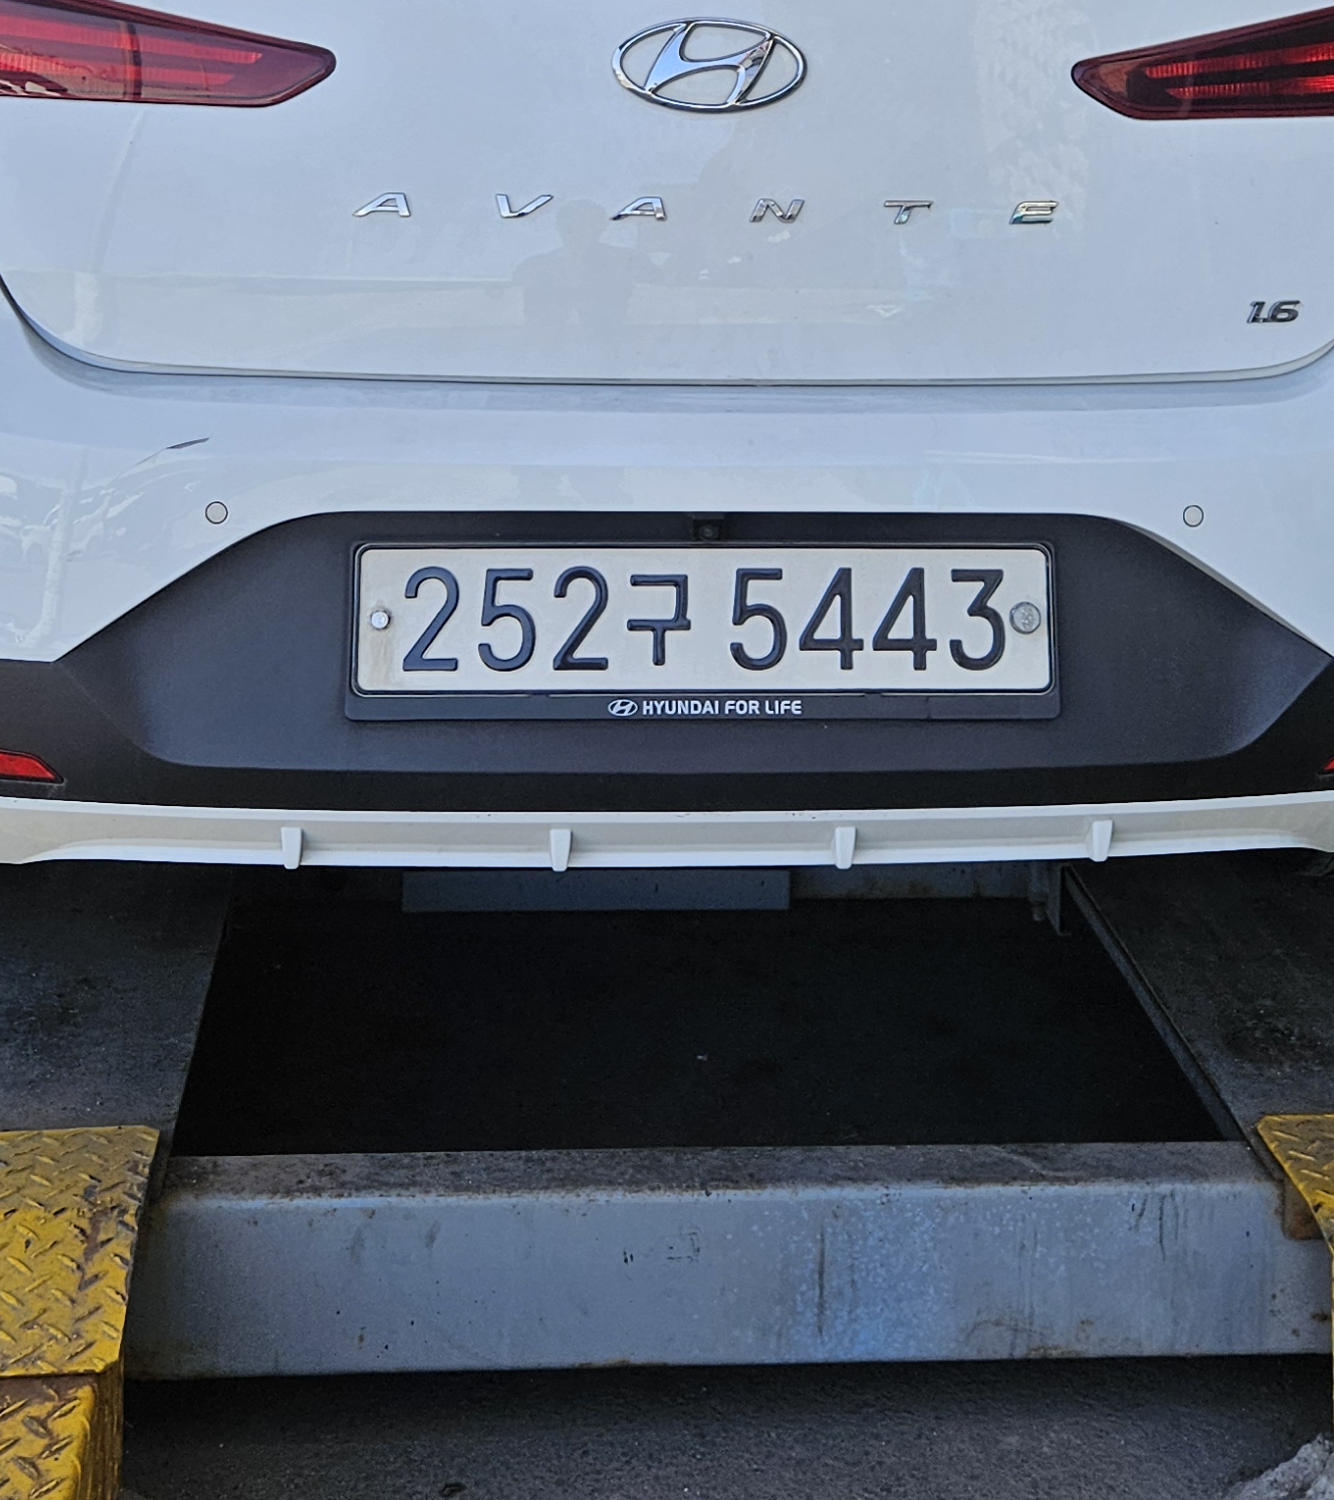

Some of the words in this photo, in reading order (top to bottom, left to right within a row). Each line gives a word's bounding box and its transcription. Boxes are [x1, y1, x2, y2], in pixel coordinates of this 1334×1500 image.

[353, 191, 1060, 226] AVANTE
[402, 566, 692, 672] 252구
[729, 566, 1006, 672] 5443
[642, 700, 719, 715] HYUNDAI
[724, 700, 760, 715] FOR
[764, 700, 802, 715] LIFE
